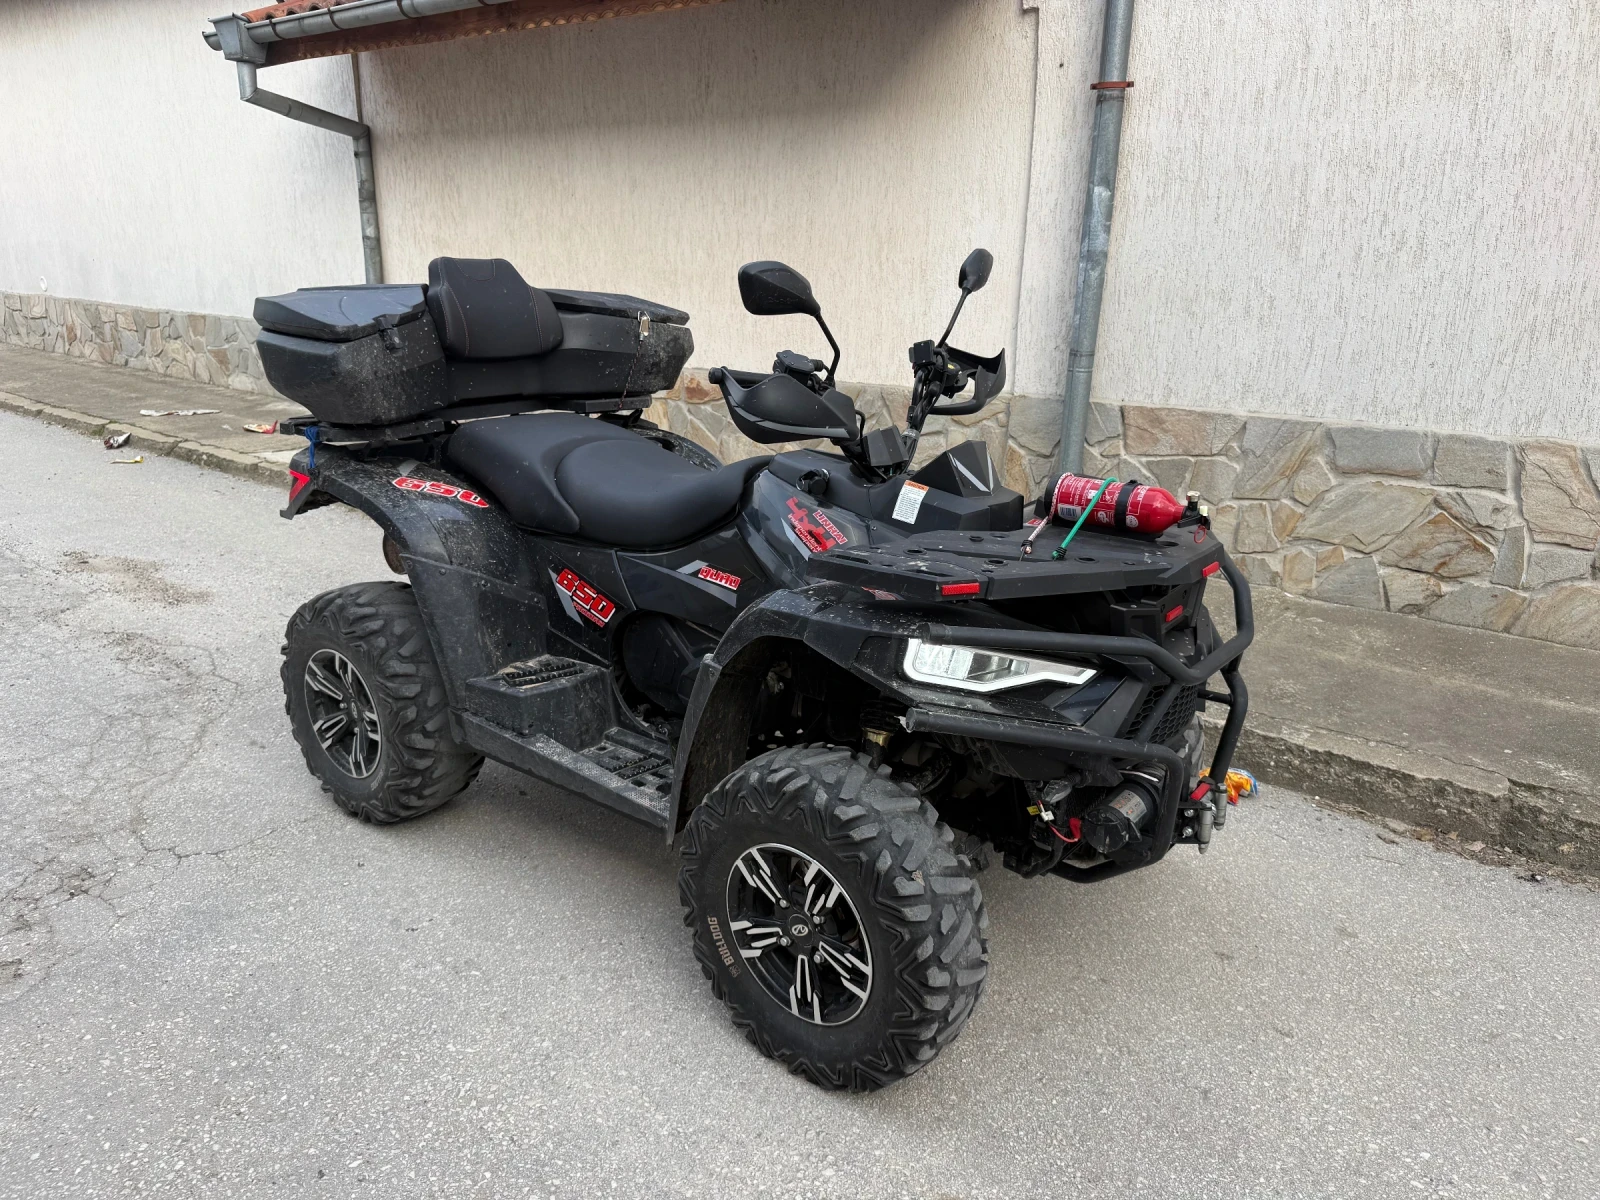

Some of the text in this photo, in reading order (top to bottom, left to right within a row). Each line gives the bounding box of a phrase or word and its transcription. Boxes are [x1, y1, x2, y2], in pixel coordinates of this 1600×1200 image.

[393, 476, 489, 508] 650
[812, 509, 848, 544] LINHAI
[556, 568, 616, 623] 650
[698, 566, 741, 590] QUAD
[707, 916, 735, 966] BULLDOG
